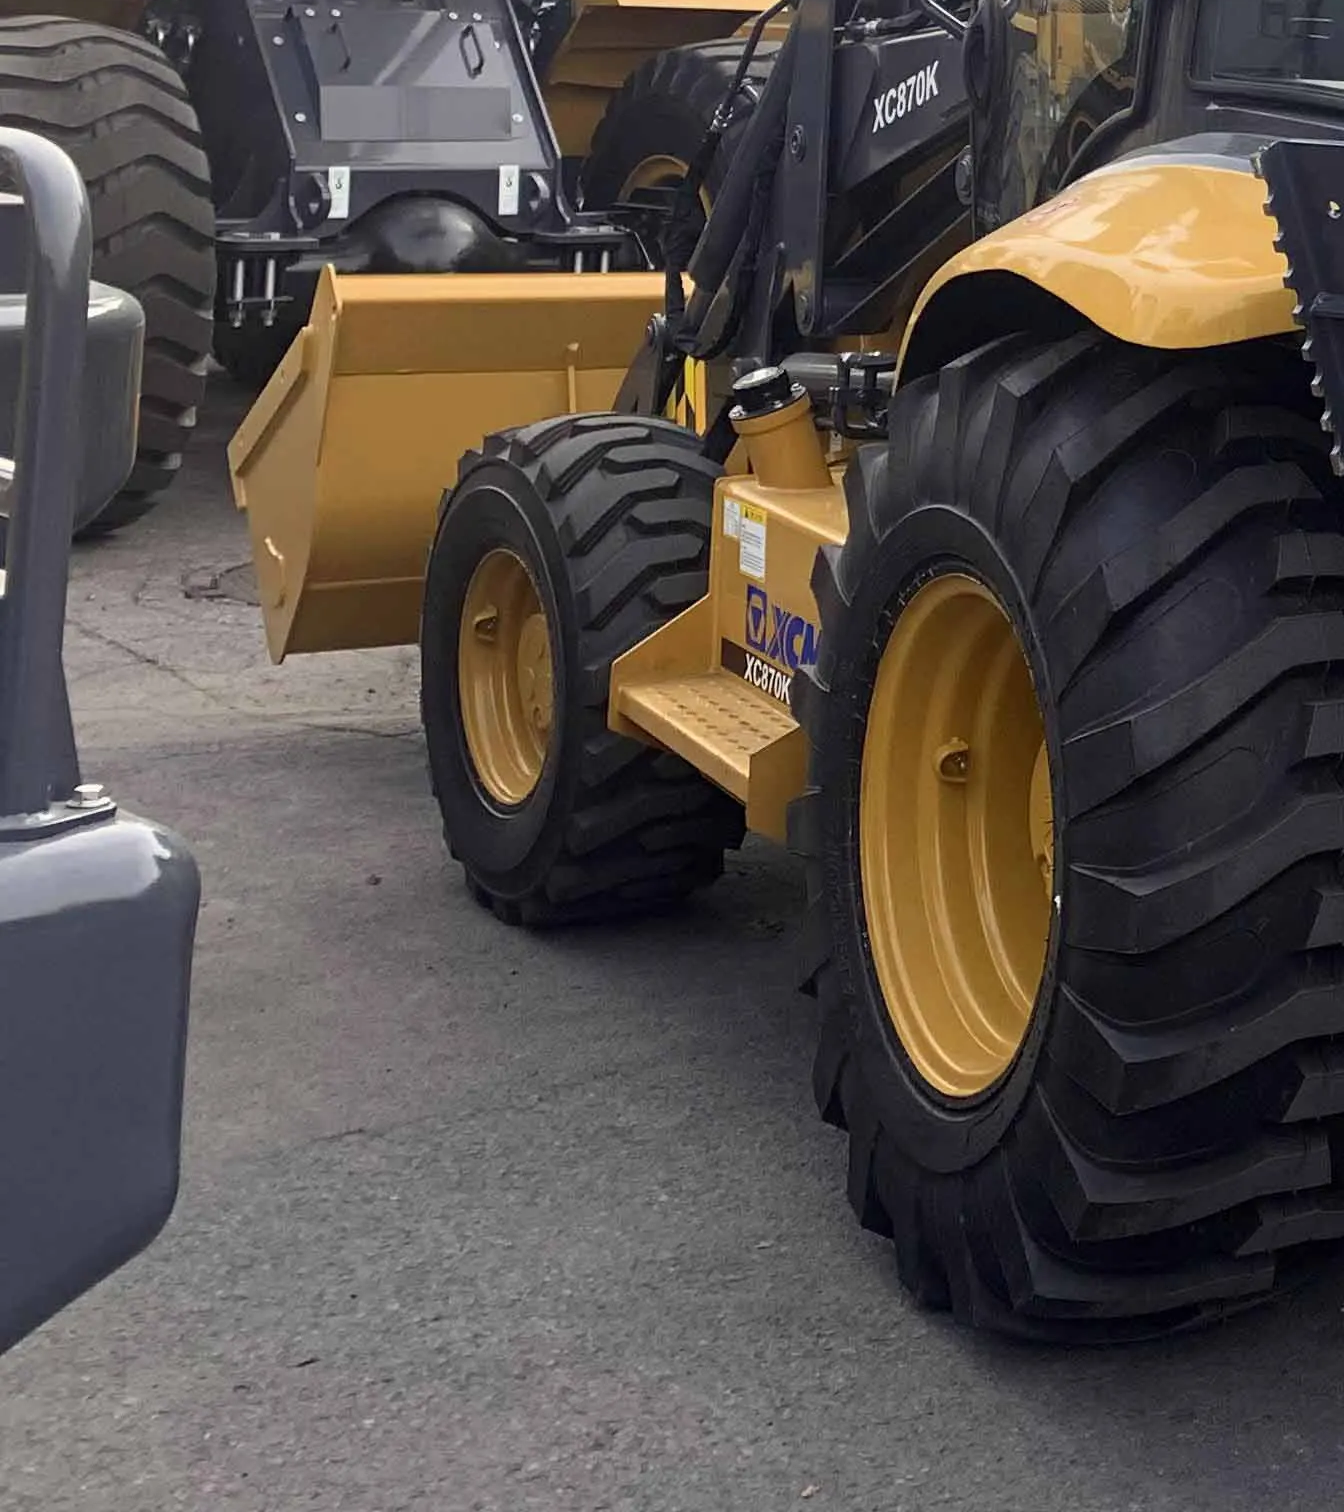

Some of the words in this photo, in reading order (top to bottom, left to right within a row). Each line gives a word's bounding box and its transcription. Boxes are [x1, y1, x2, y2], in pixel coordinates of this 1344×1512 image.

[872, 60, 939, 134] XC870K
[766, 602, 823, 670] XCM
[743, 652, 792, 705] XC870K
